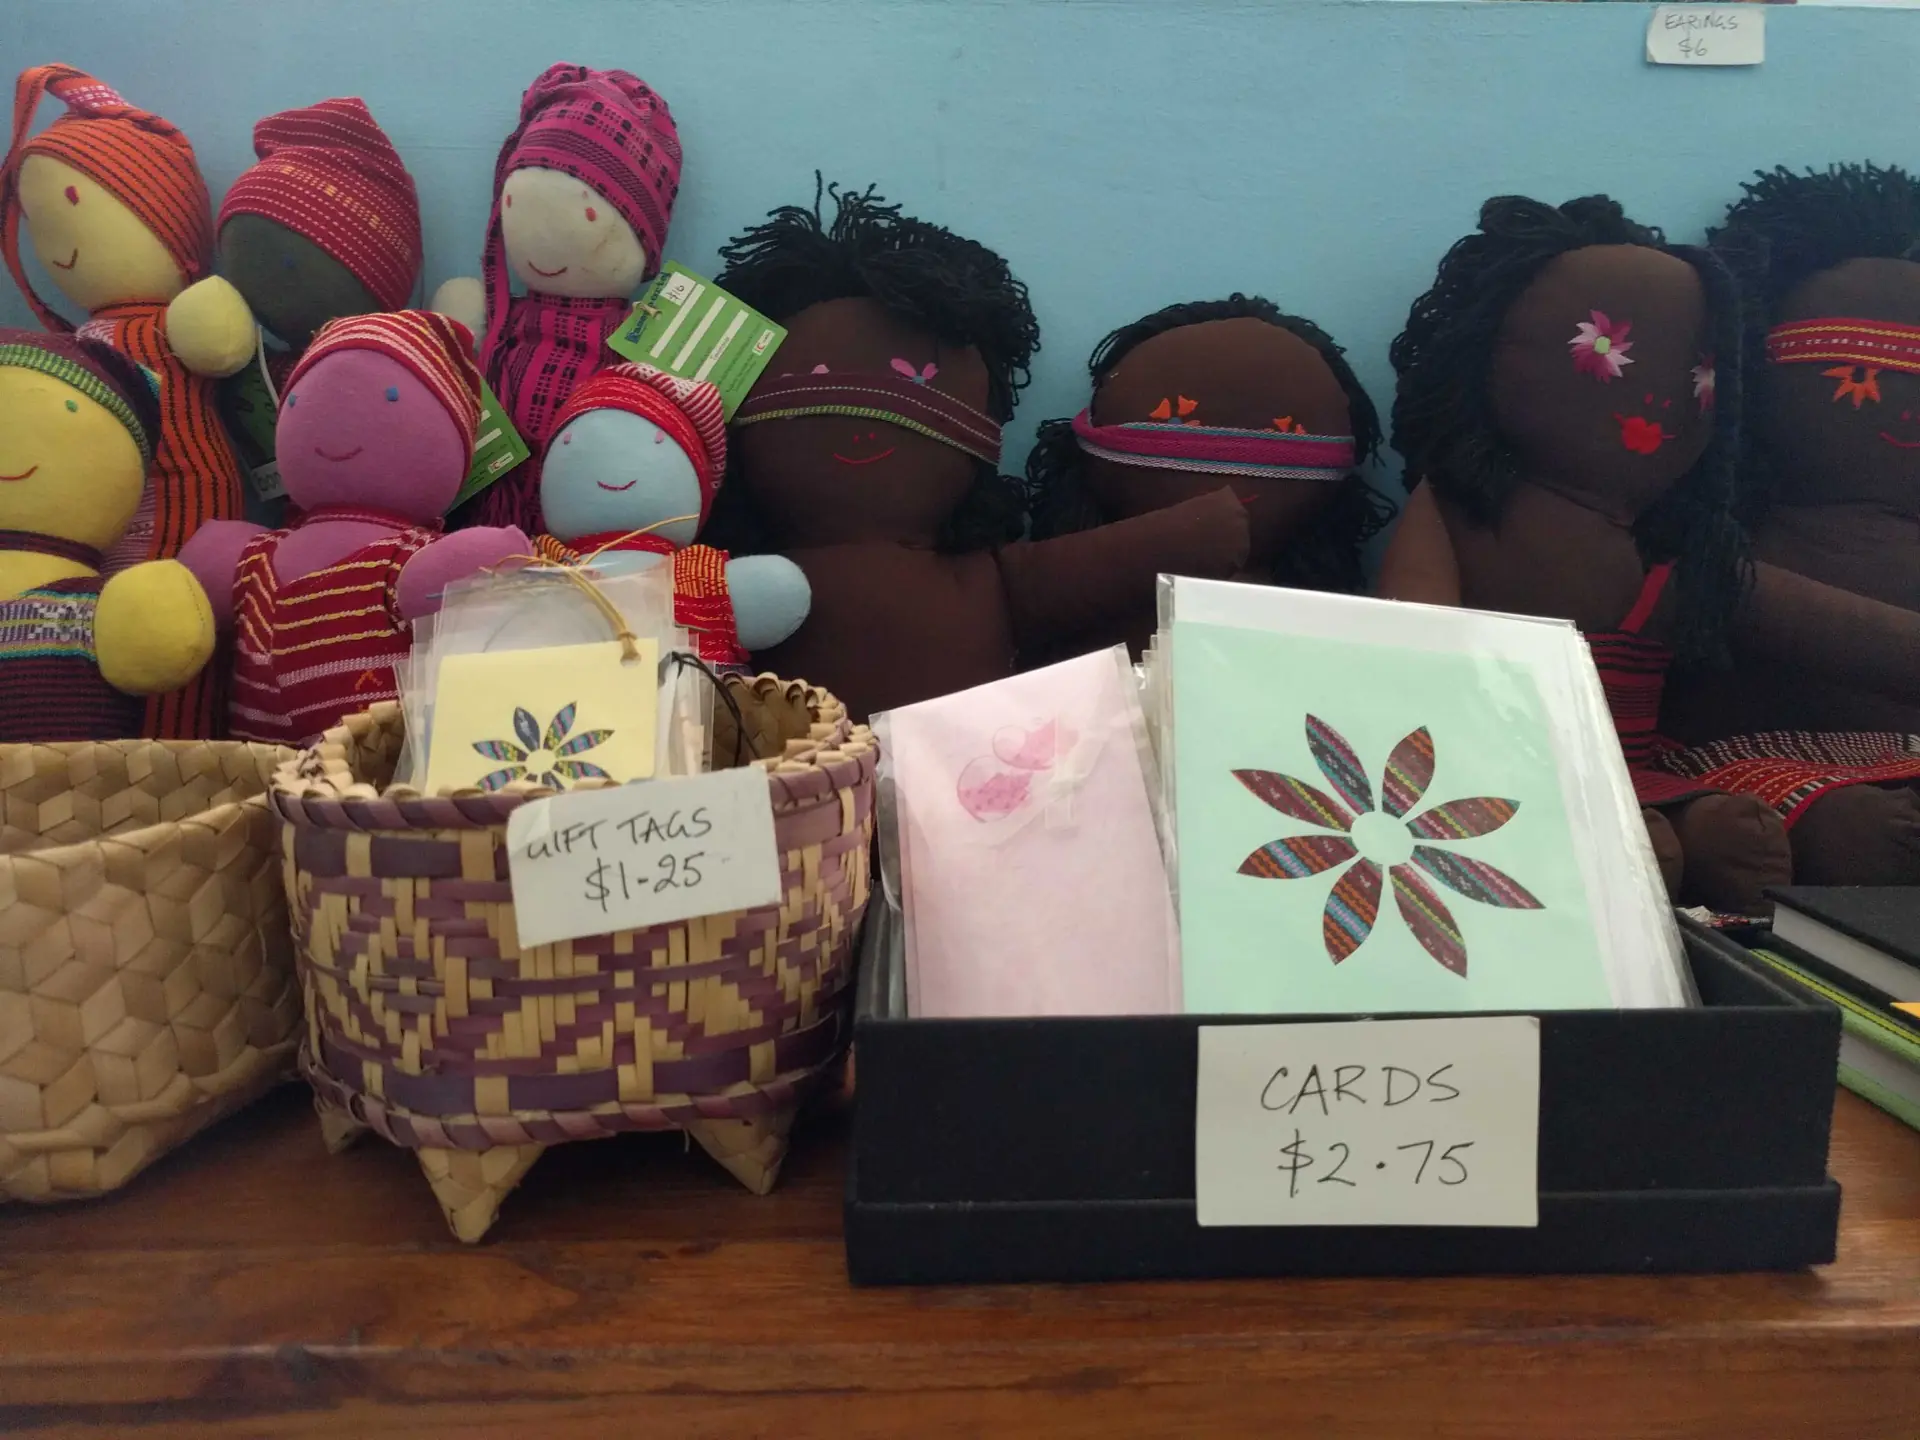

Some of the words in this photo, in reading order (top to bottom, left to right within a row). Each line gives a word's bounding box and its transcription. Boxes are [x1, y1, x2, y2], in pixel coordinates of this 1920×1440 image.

[1677, 34, 1708, 58] $6
[616, 807, 712, 845] TAGS
[1261, 1064, 1460, 1115] CARDS
